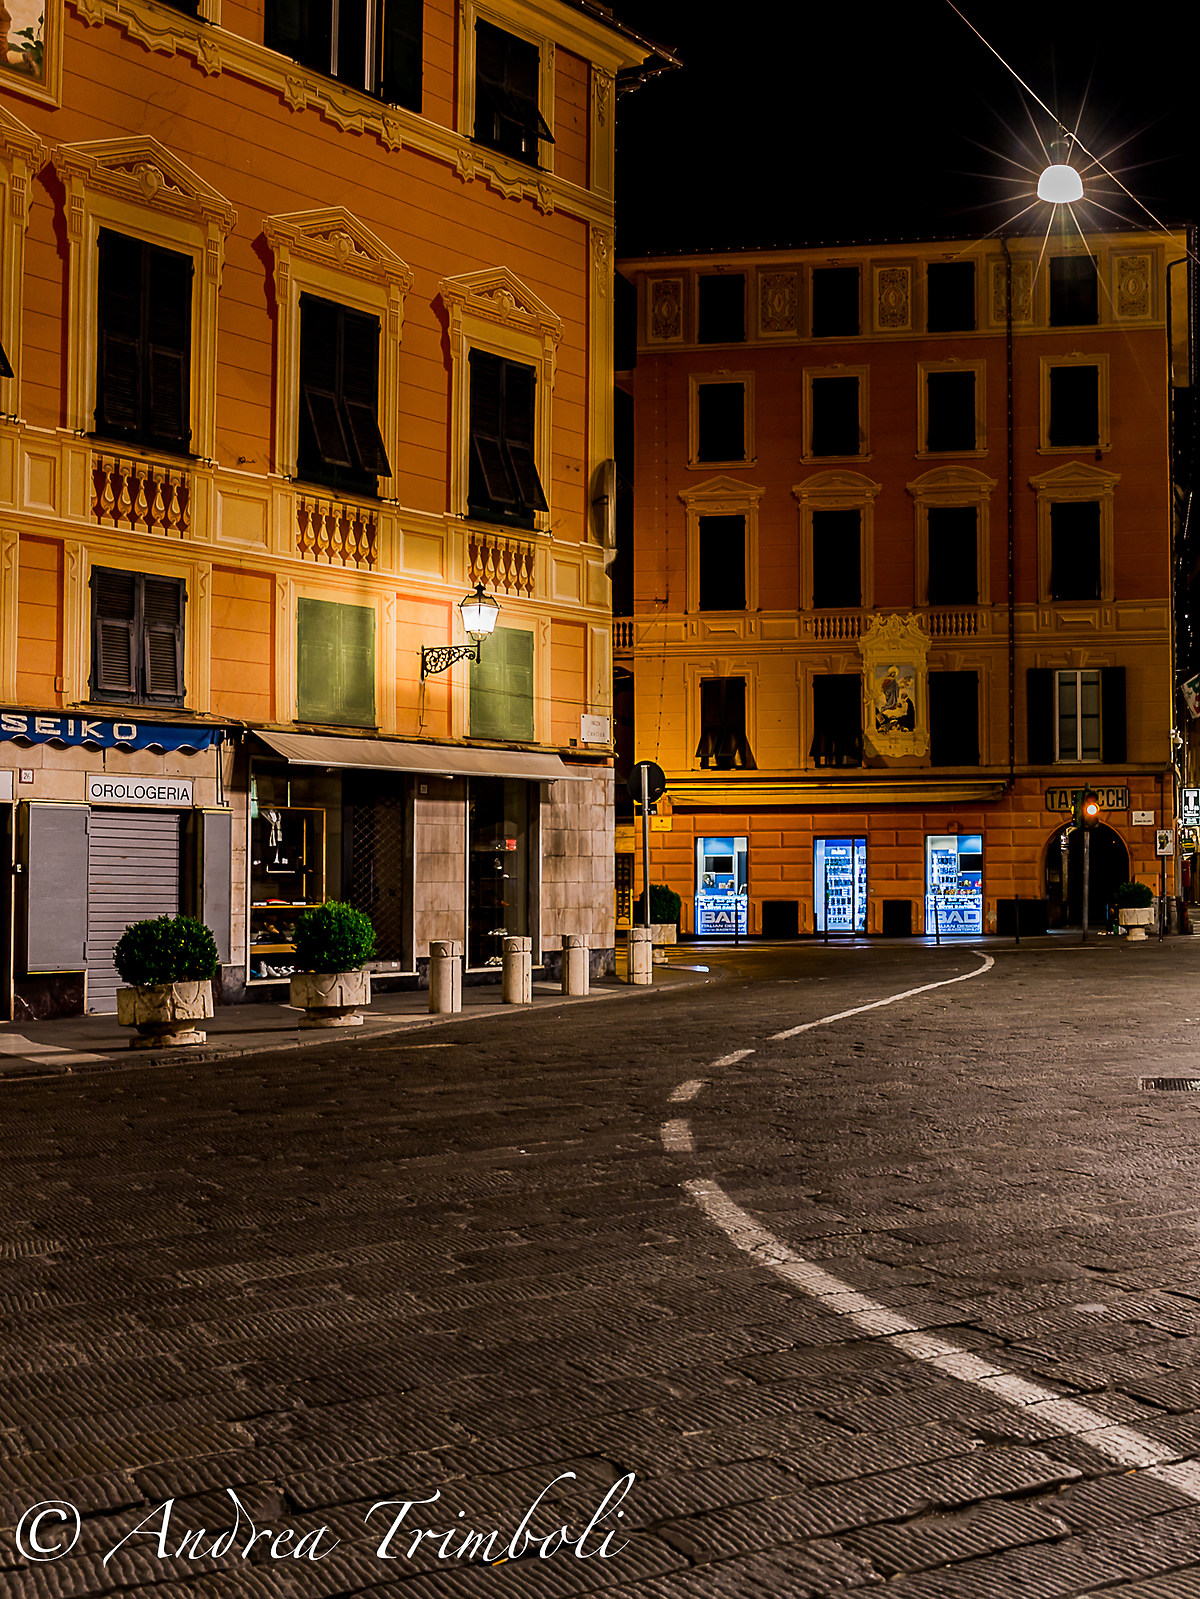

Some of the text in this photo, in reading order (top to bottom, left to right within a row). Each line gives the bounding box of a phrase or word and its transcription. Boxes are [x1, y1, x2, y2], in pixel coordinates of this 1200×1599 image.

[1, 713, 137, 740] SEIKO
[91, 783, 190, 801] OROLOGERIA
[1047, 788, 1128, 809] TACCHI
[701, 911, 746, 924] BAD
[931, 910, 980, 924] BAD
